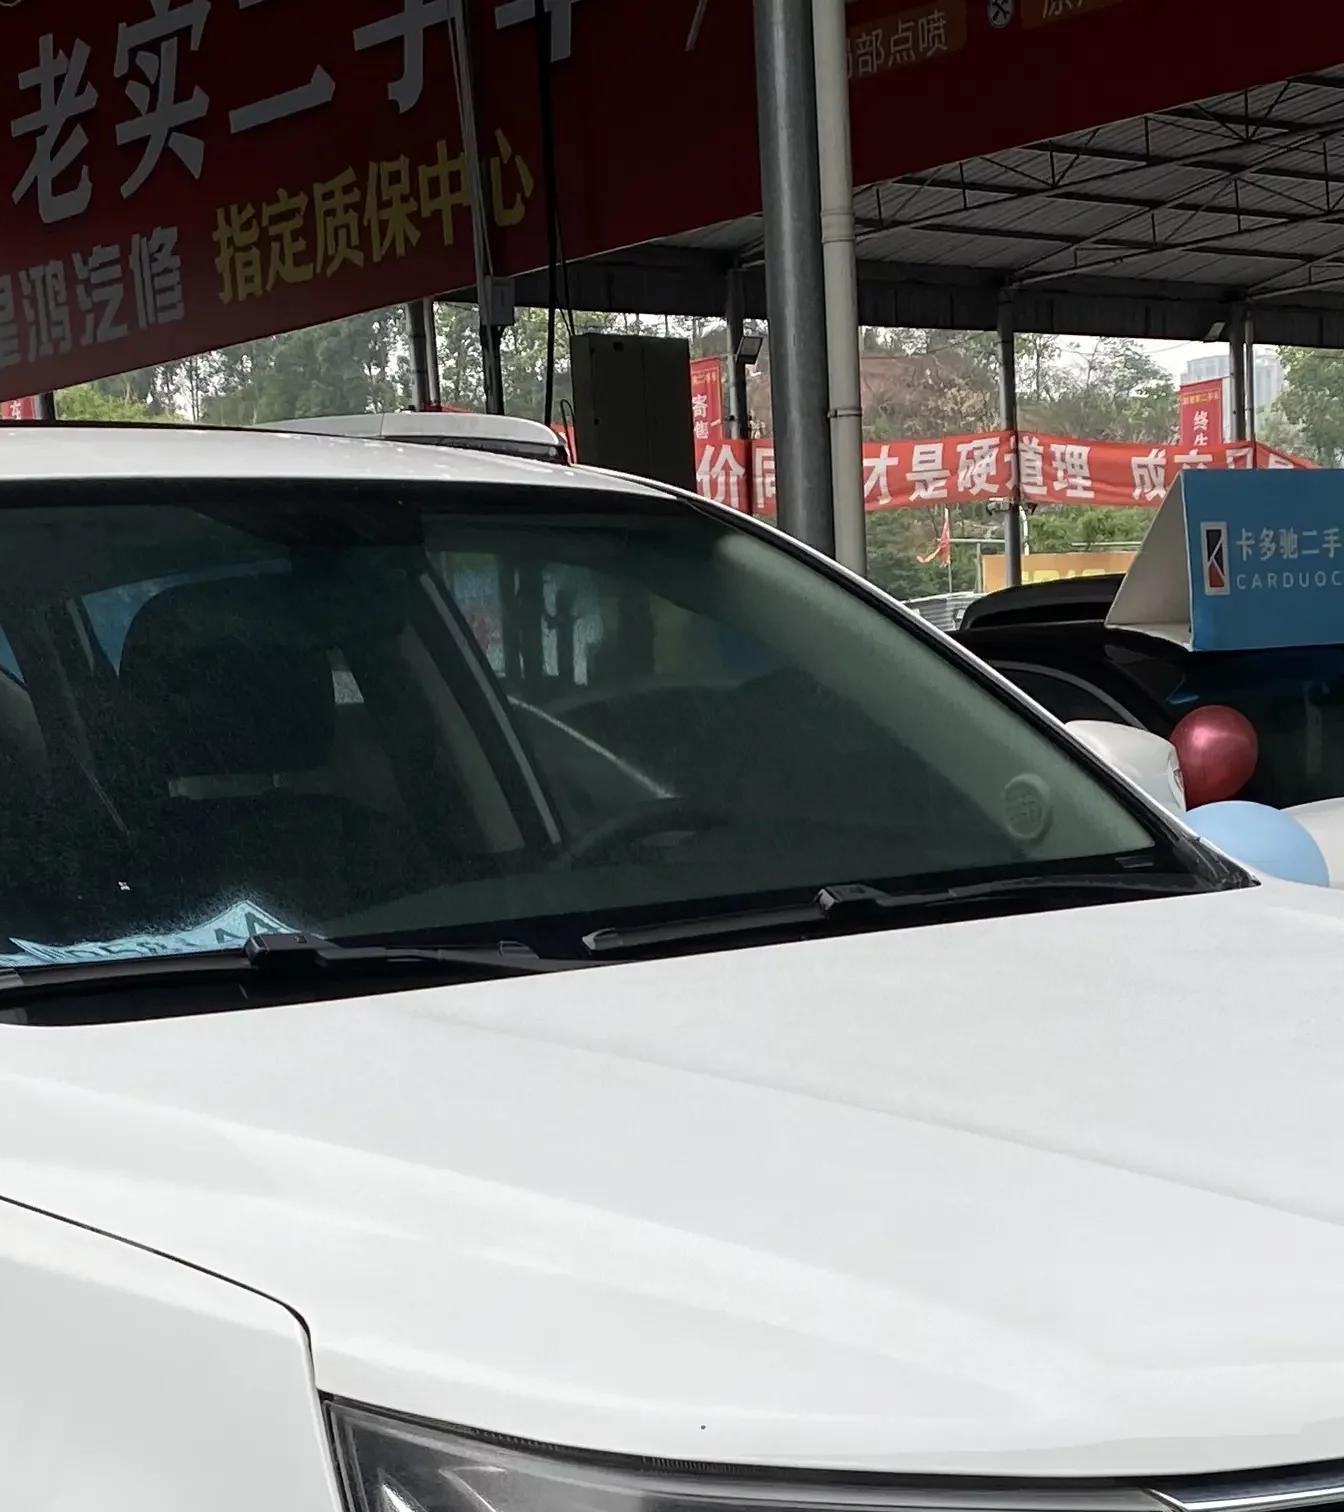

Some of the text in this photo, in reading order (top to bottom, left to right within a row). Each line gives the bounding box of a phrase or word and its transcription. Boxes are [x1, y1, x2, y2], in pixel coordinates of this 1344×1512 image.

[212, 127, 534, 304] 指定质保中心
